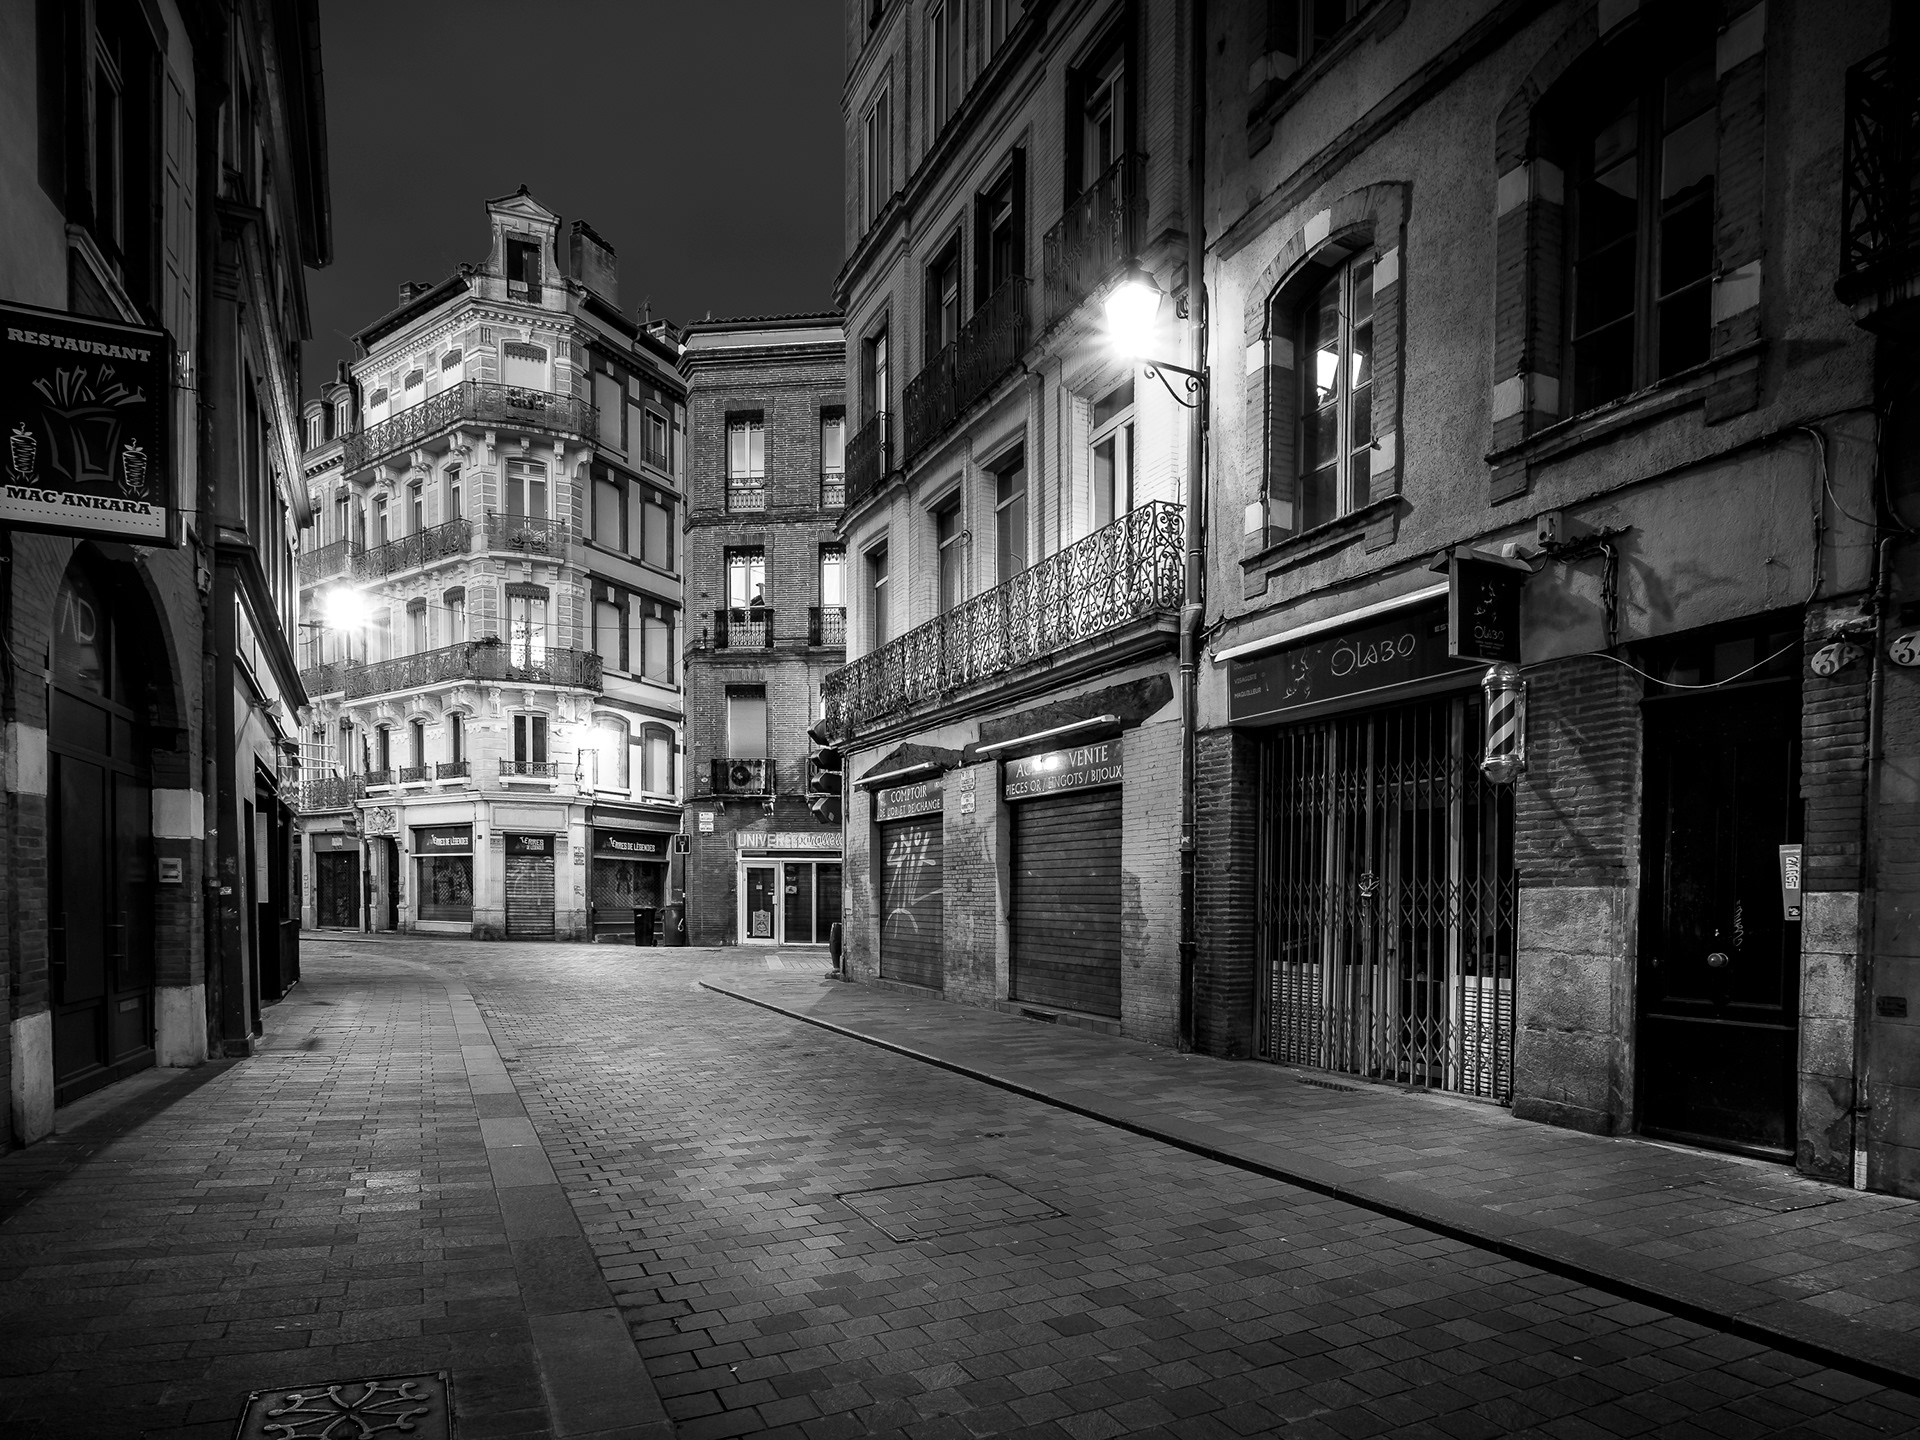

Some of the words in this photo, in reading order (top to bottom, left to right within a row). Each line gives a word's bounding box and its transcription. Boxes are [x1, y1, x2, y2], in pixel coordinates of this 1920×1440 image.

[7, 327, 151, 362] RESTAURANT
[6, 486, 57, 504] MAC
[62, 493, 152, 515] ANKARA
[1898, 636, 1920, 664] 3
[1069, 745, 1108, 767] VENTE
[891, 785, 927, 803] COMPTOIR
[1006, 781, 1028, 796] PIECES
[1030, 779, 1042, 791] OR
[1091, 764, 1122, 783] BIJOUX
[900, 804, 906, 815] ET
[916, 798, 940, 812] CHANGE
